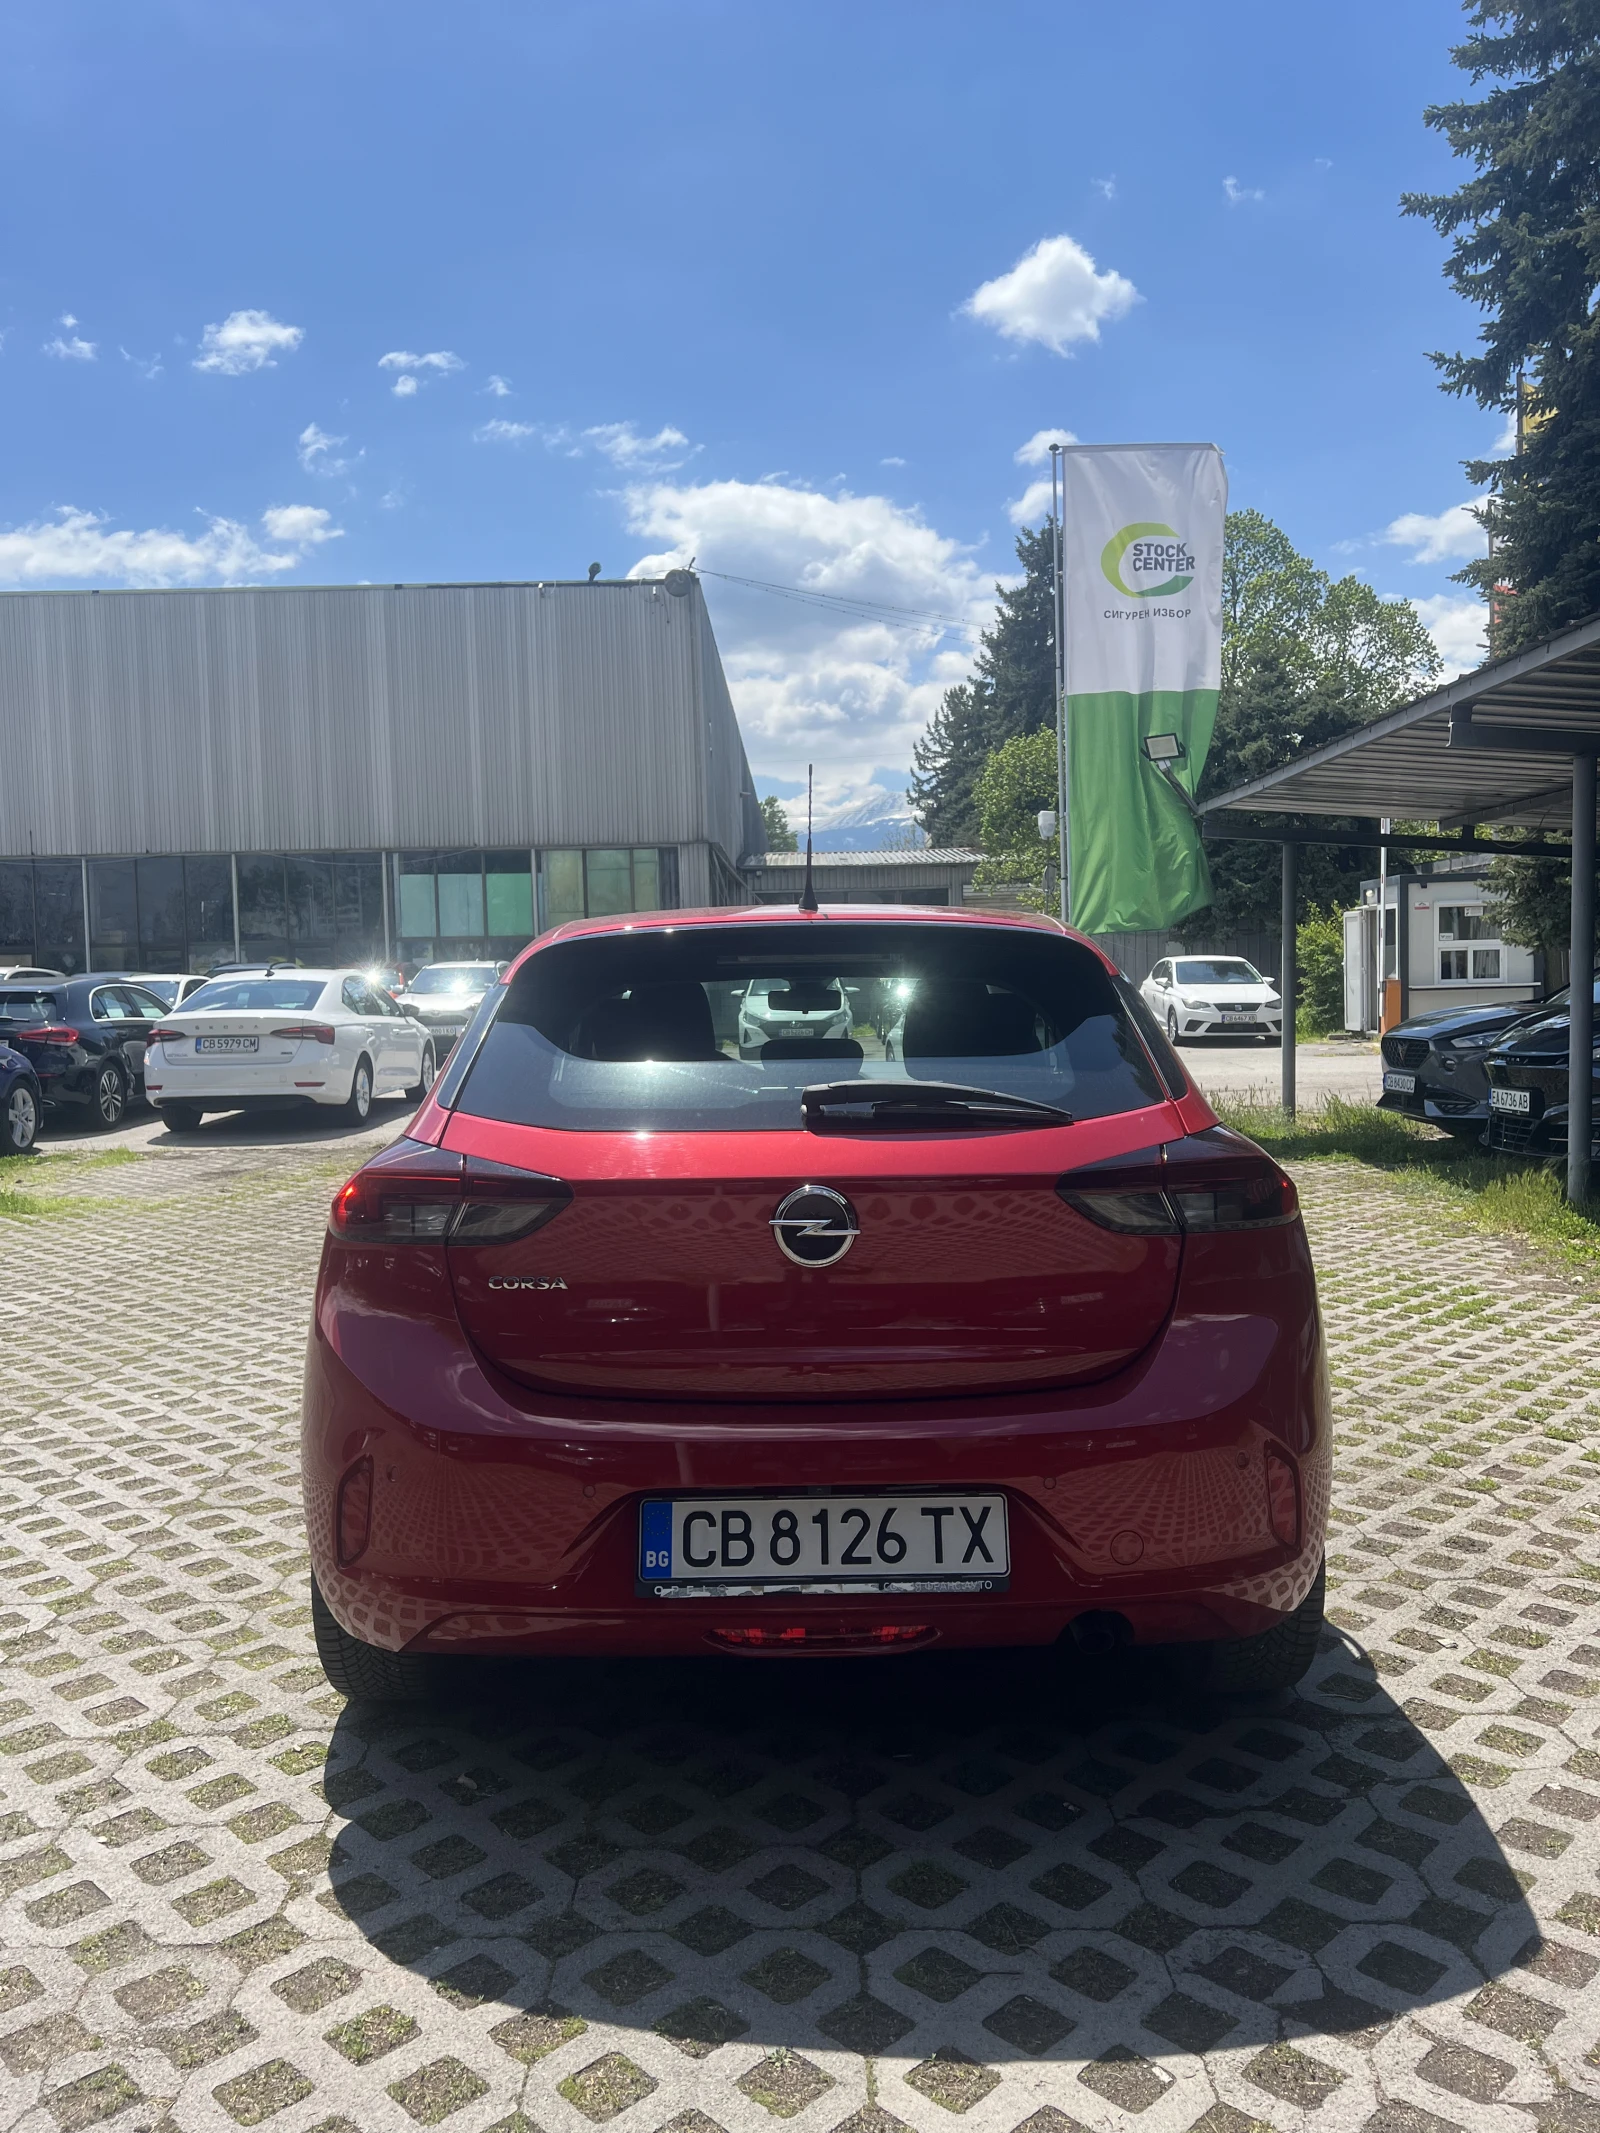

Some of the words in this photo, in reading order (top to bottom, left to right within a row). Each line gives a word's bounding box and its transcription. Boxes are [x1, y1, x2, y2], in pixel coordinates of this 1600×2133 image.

[1133, 542, 1187, 558] STOCK
[1133, 556, 1195, 572] CENTER
[1103, 608, 1150, 620] СИГУРЕН
[1153, 608, 1191, 618] ИЗБОР
[203, 1039, 215, 1049] CB
[217, 1039, 241, 1048] 5979
[243, 1039, 256, 1048] CM
[1492, 1090, 1500, 1105] EA
[1500, 1091, 1517, 1108] 6736
[1518, 1093, 1529, 1109] AB
[488, 1275, 569, 1290] CORSA
[682, 1510, 755, 1568] CB
[769, 1508, 908, 1566] 8126
[920, 1506, 994, 1564] TX
[645, 1550, 669, 1568] BG
